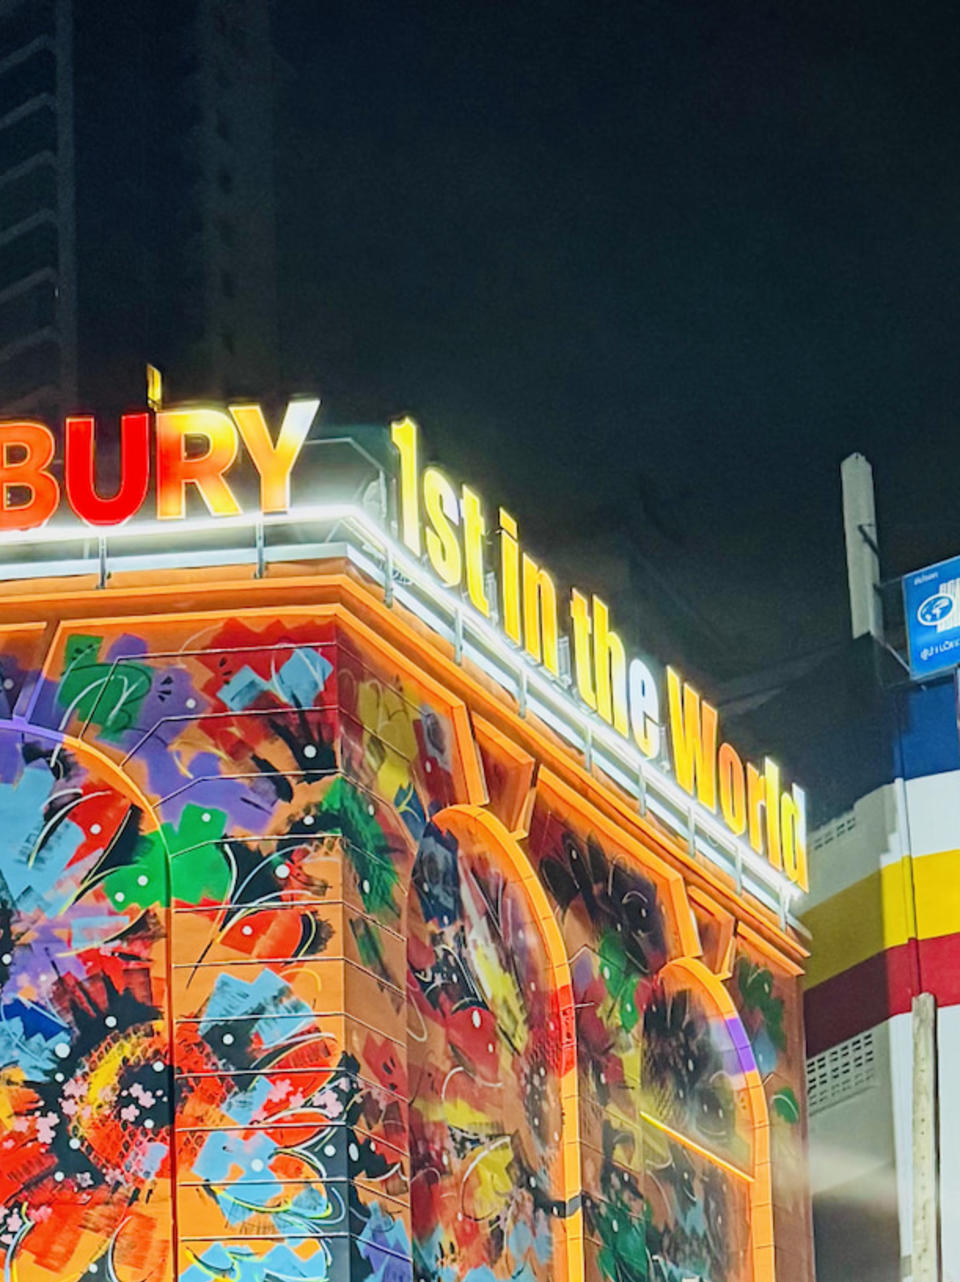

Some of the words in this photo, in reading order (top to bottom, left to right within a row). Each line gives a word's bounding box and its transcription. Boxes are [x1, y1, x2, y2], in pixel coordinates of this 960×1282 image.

[391, 416, 489, 617] 1st
[499, 507, 559, 675] in
[570, 588, 659, 760] the
[666, 665, 809, 892] World
